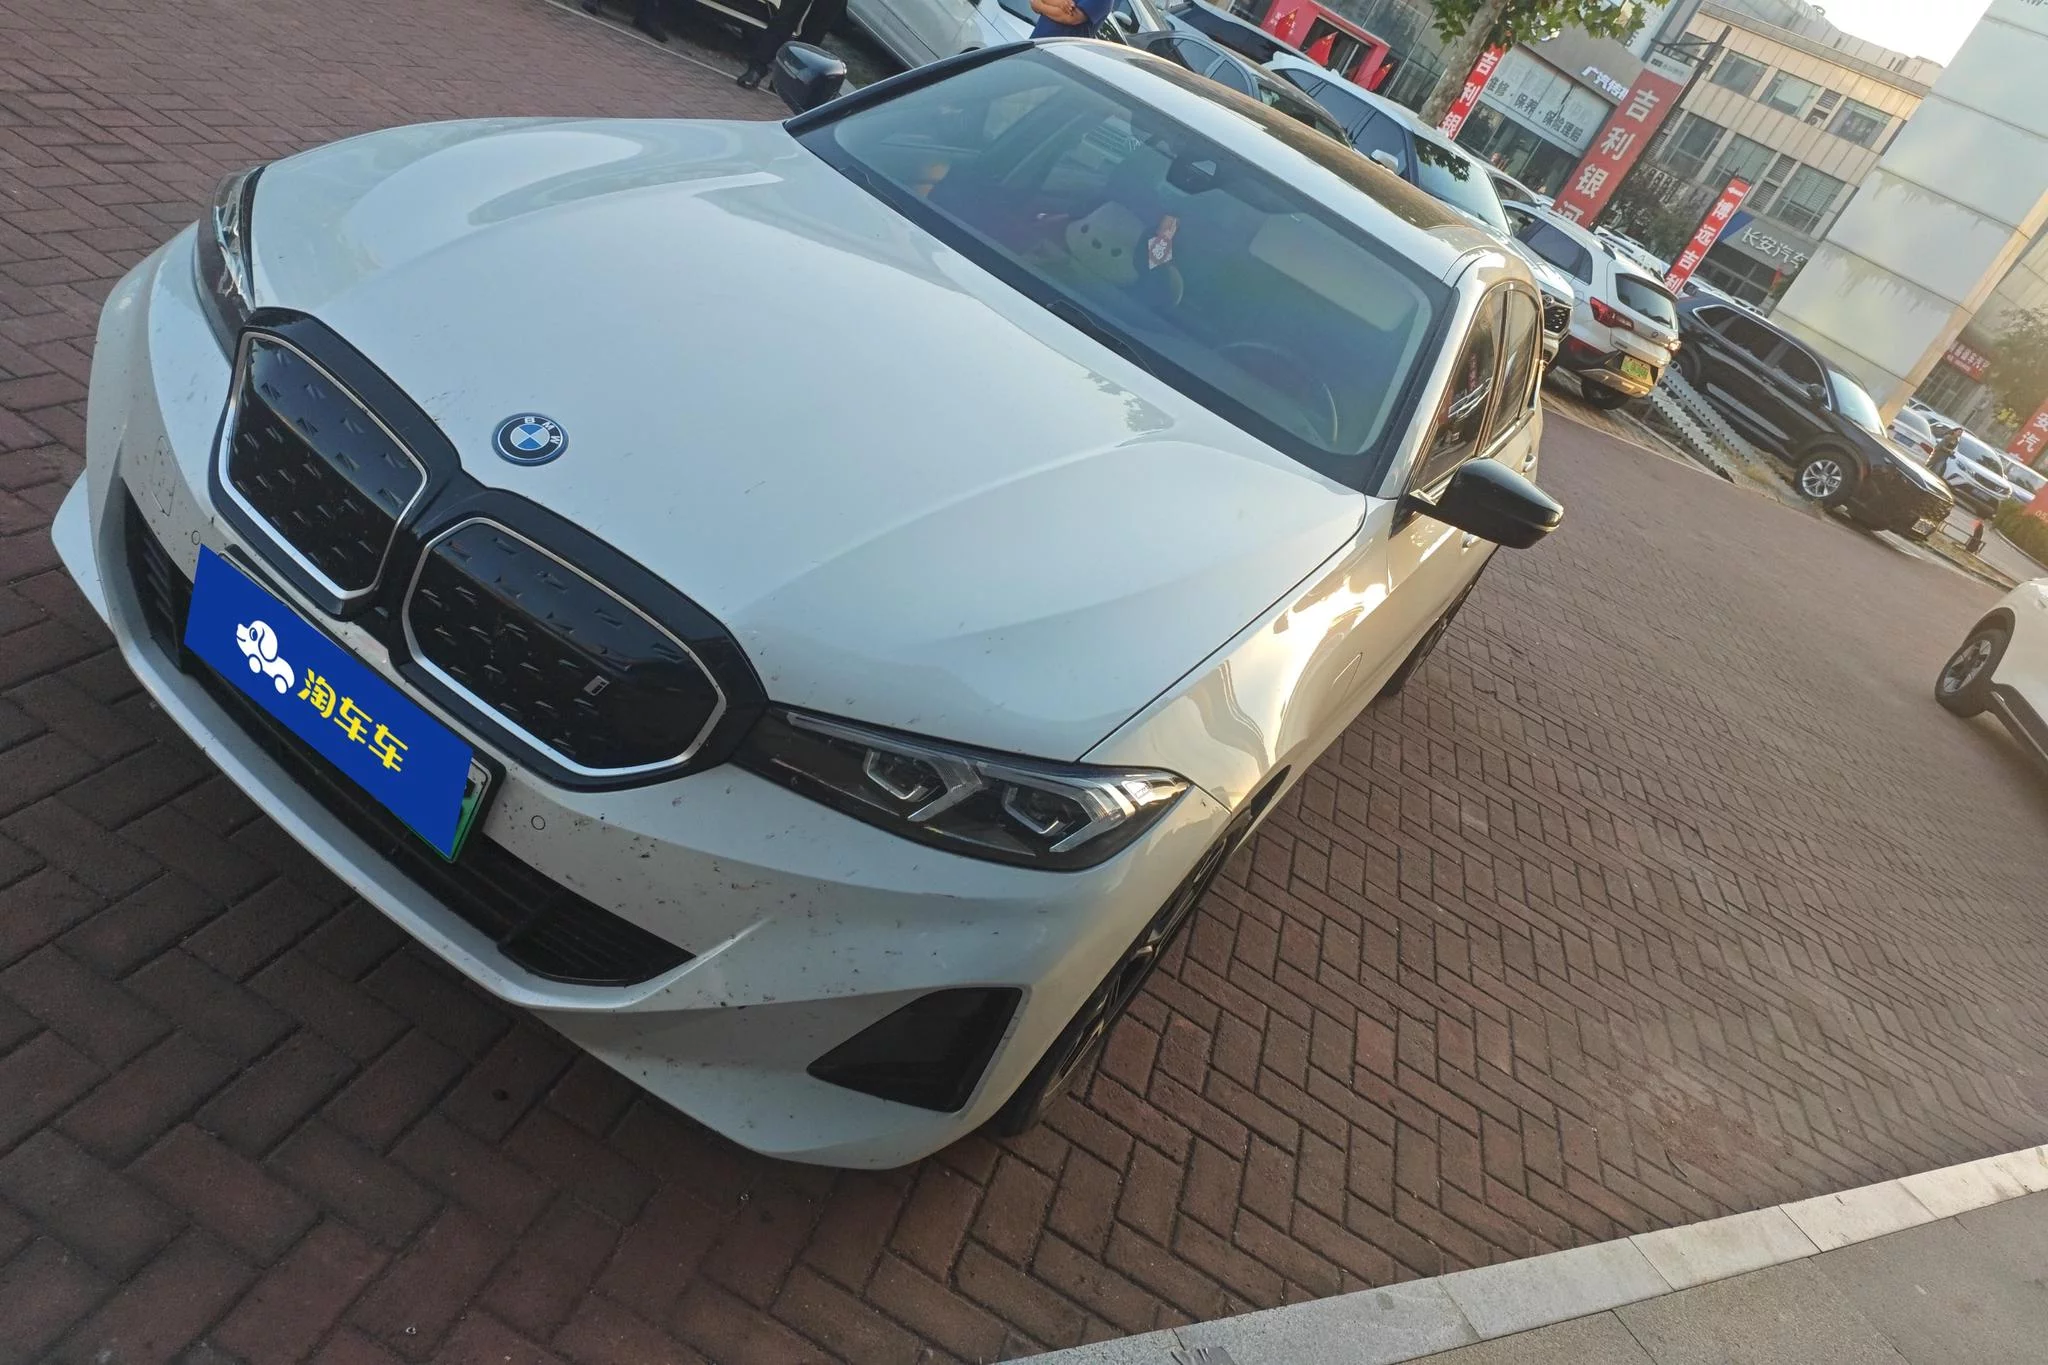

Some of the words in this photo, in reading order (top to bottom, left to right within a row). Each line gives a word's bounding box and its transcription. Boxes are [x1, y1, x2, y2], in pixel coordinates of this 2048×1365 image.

[1741, 226, 1810, 269] 长安汽车
[524, 416, 562, 445] BMW
[2007, 412, 2048, 462] 安汽
